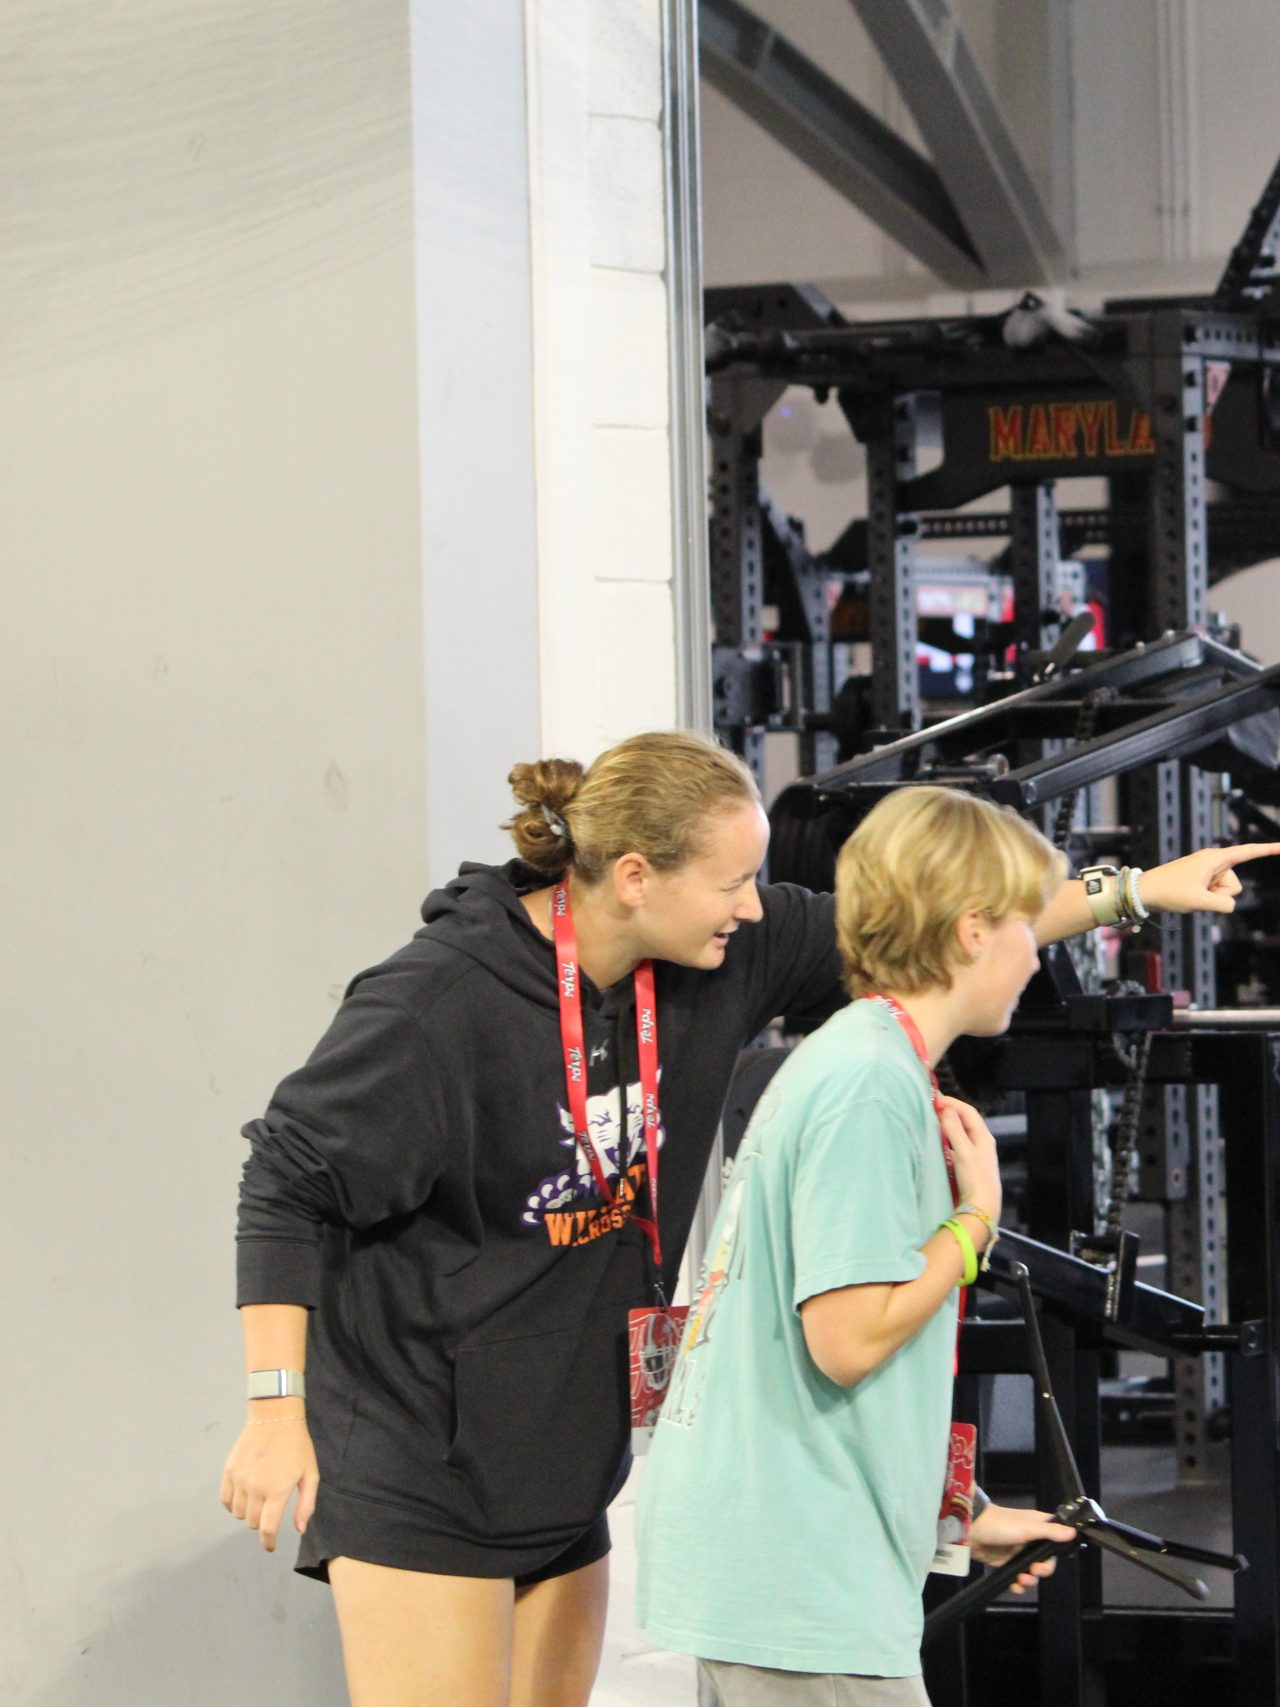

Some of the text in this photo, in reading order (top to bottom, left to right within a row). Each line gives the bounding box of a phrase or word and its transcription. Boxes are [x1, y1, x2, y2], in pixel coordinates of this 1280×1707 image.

[989, 401, 1211, 460] MARYLA
[561, 962, 576, 998] Terps
[638, 1008, 656, 1044] Terps
[567, 1046, 583, 1082] Terps
